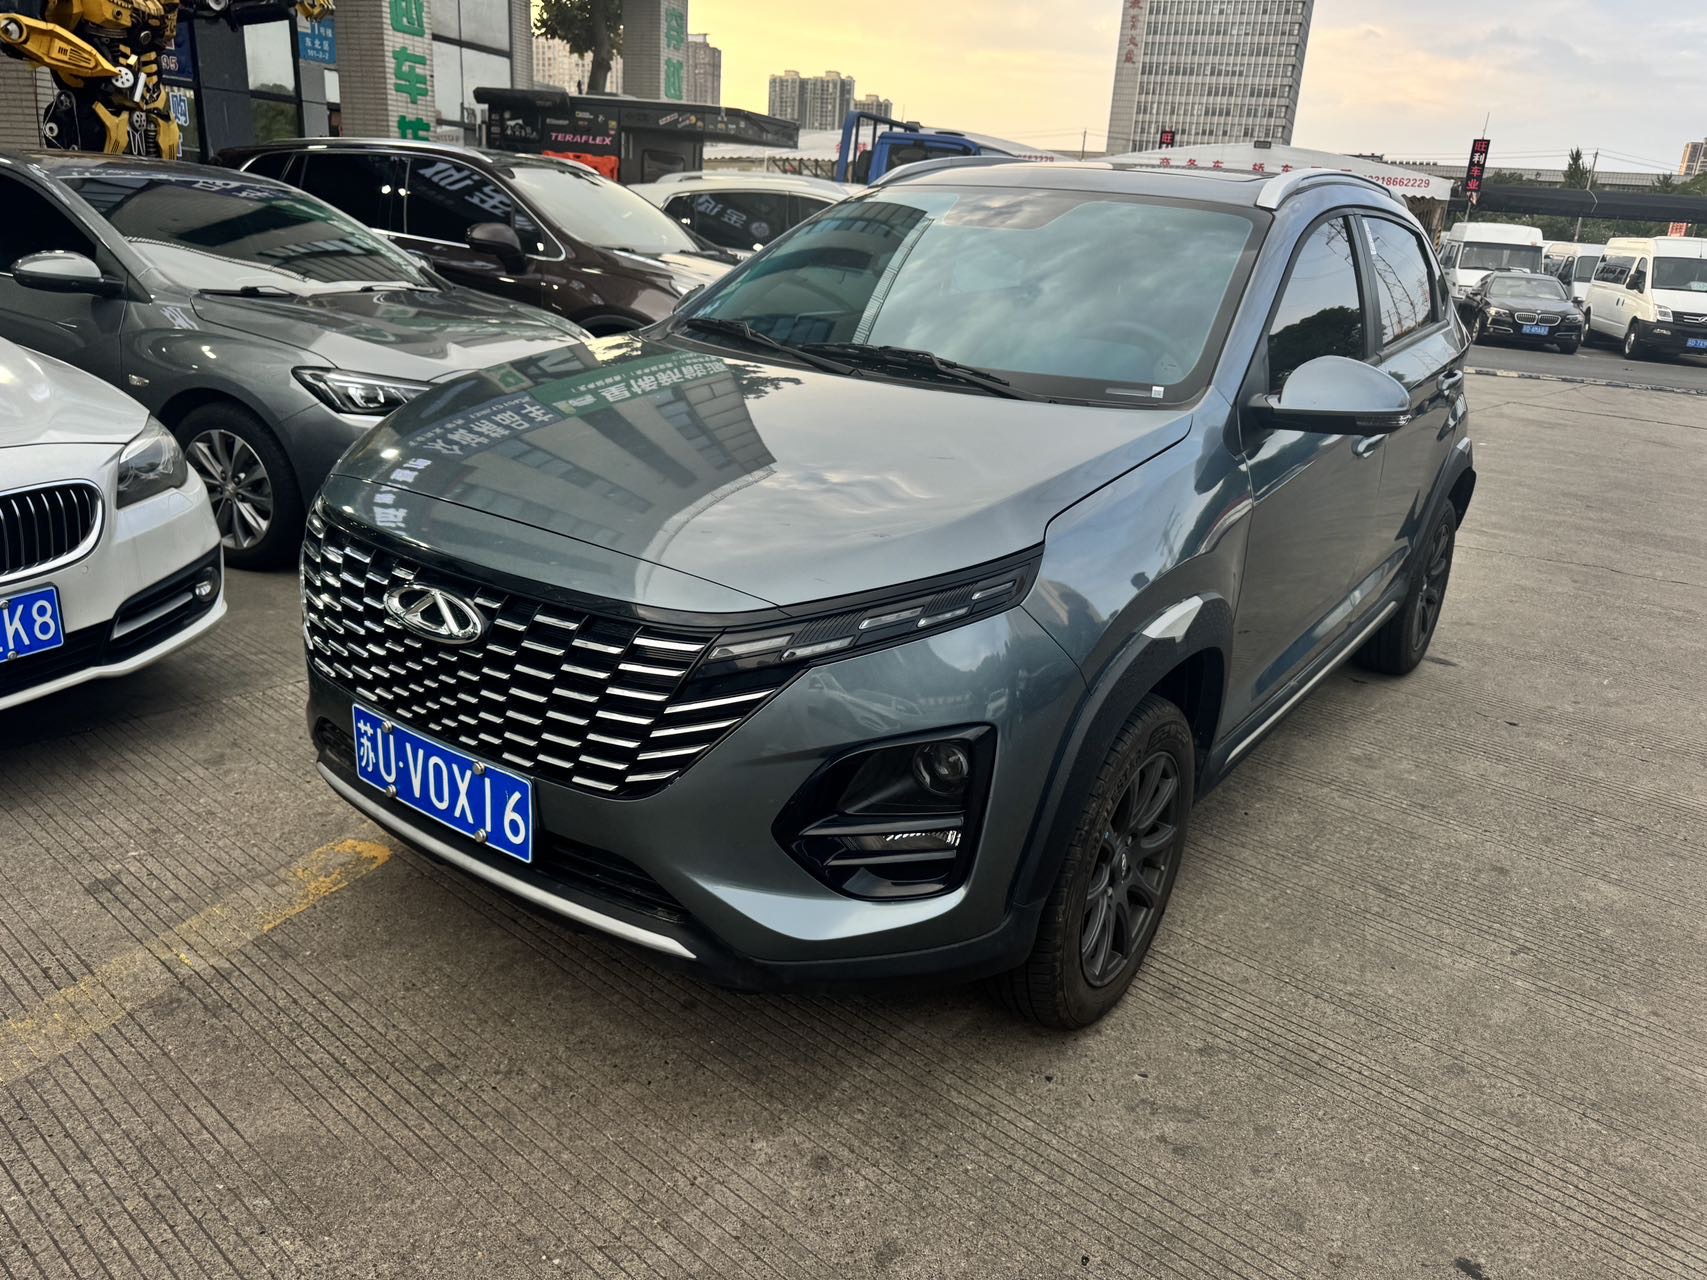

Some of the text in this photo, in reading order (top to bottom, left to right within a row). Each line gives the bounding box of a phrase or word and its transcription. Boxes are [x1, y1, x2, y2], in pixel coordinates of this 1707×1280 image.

[549, 132, 613, 146] TERAFLEX
[1465, 140, 1489, 191] 旺利车业
[0, 599, 57, 653] K8
